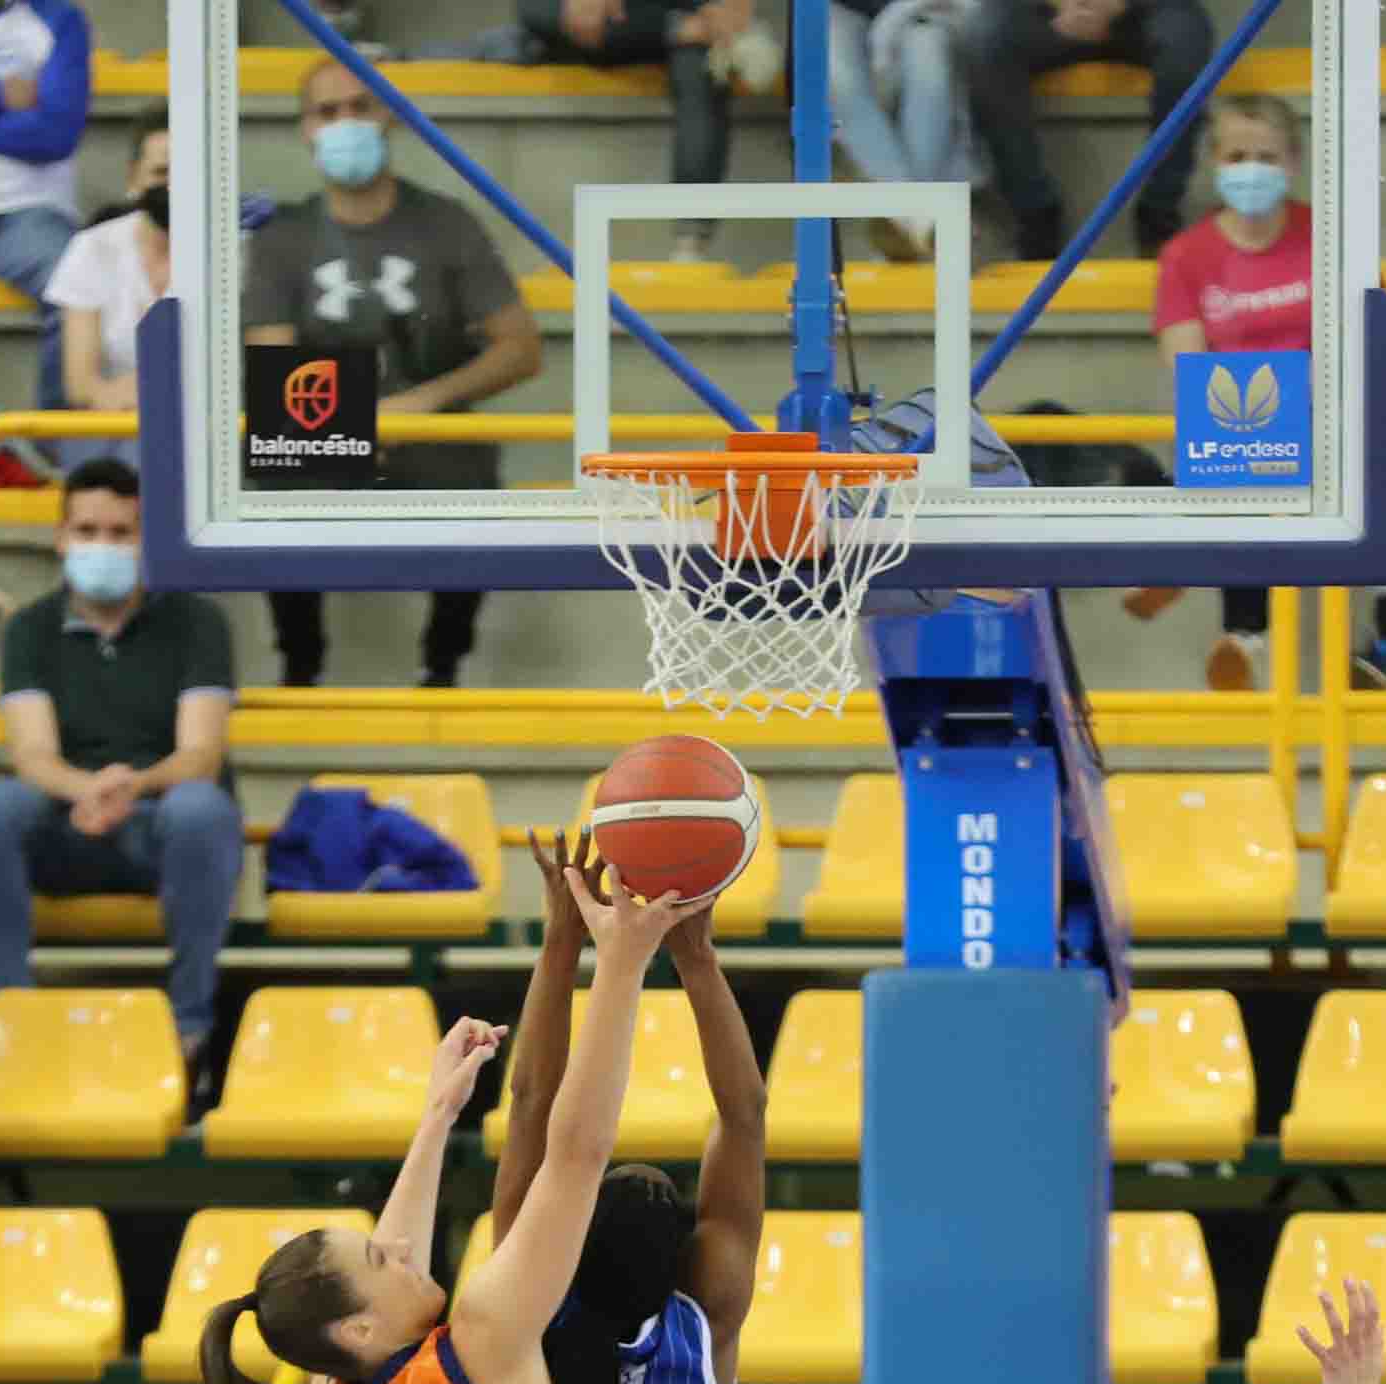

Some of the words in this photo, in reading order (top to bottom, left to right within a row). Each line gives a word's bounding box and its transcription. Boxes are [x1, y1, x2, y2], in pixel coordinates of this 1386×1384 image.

[250, 433, 372, 456] baloncesto
[1188, 440, 1218, 459] LF
[1219, 440, 1300, 458] endesa
[958, 813, 997, 970] MONDO
